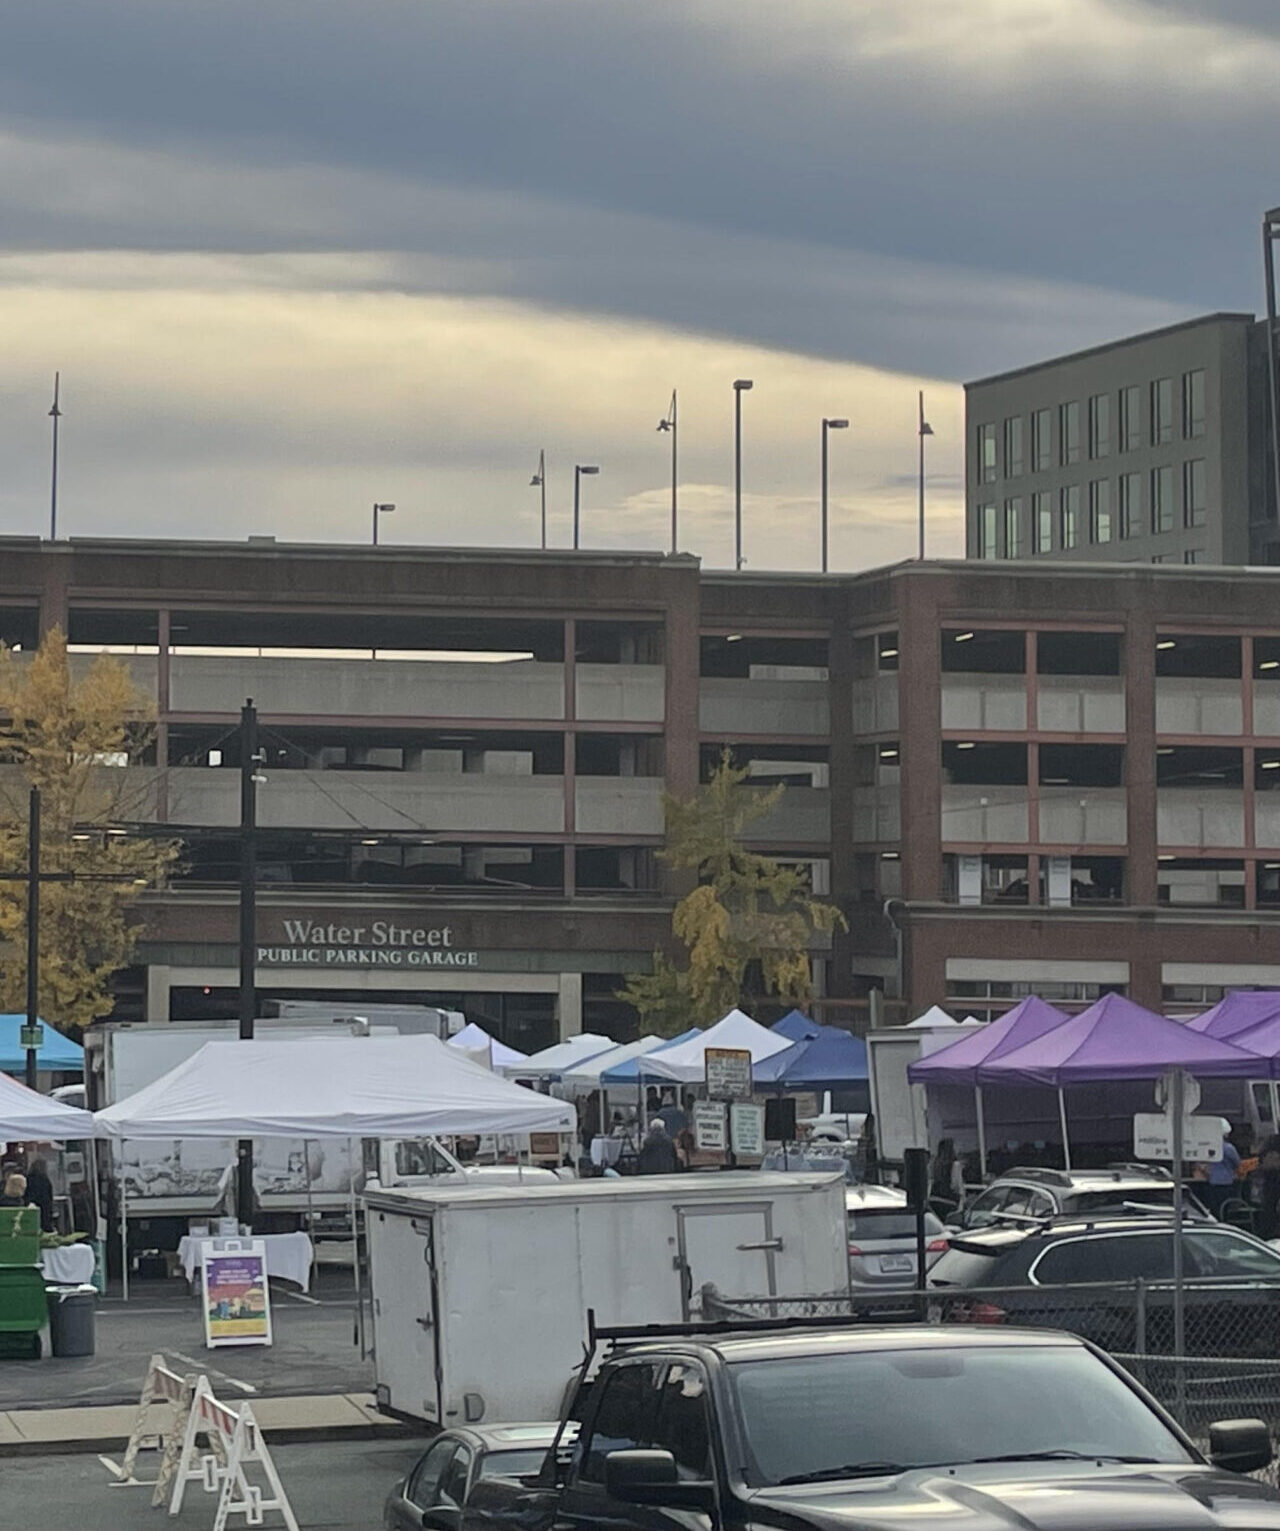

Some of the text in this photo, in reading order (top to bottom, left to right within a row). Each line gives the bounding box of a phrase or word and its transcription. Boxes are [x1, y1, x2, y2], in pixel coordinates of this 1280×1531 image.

[282, 920, 452, 947] Water Street
[257, 948, 479, 966] PUBLIC PARKING GARAGE
